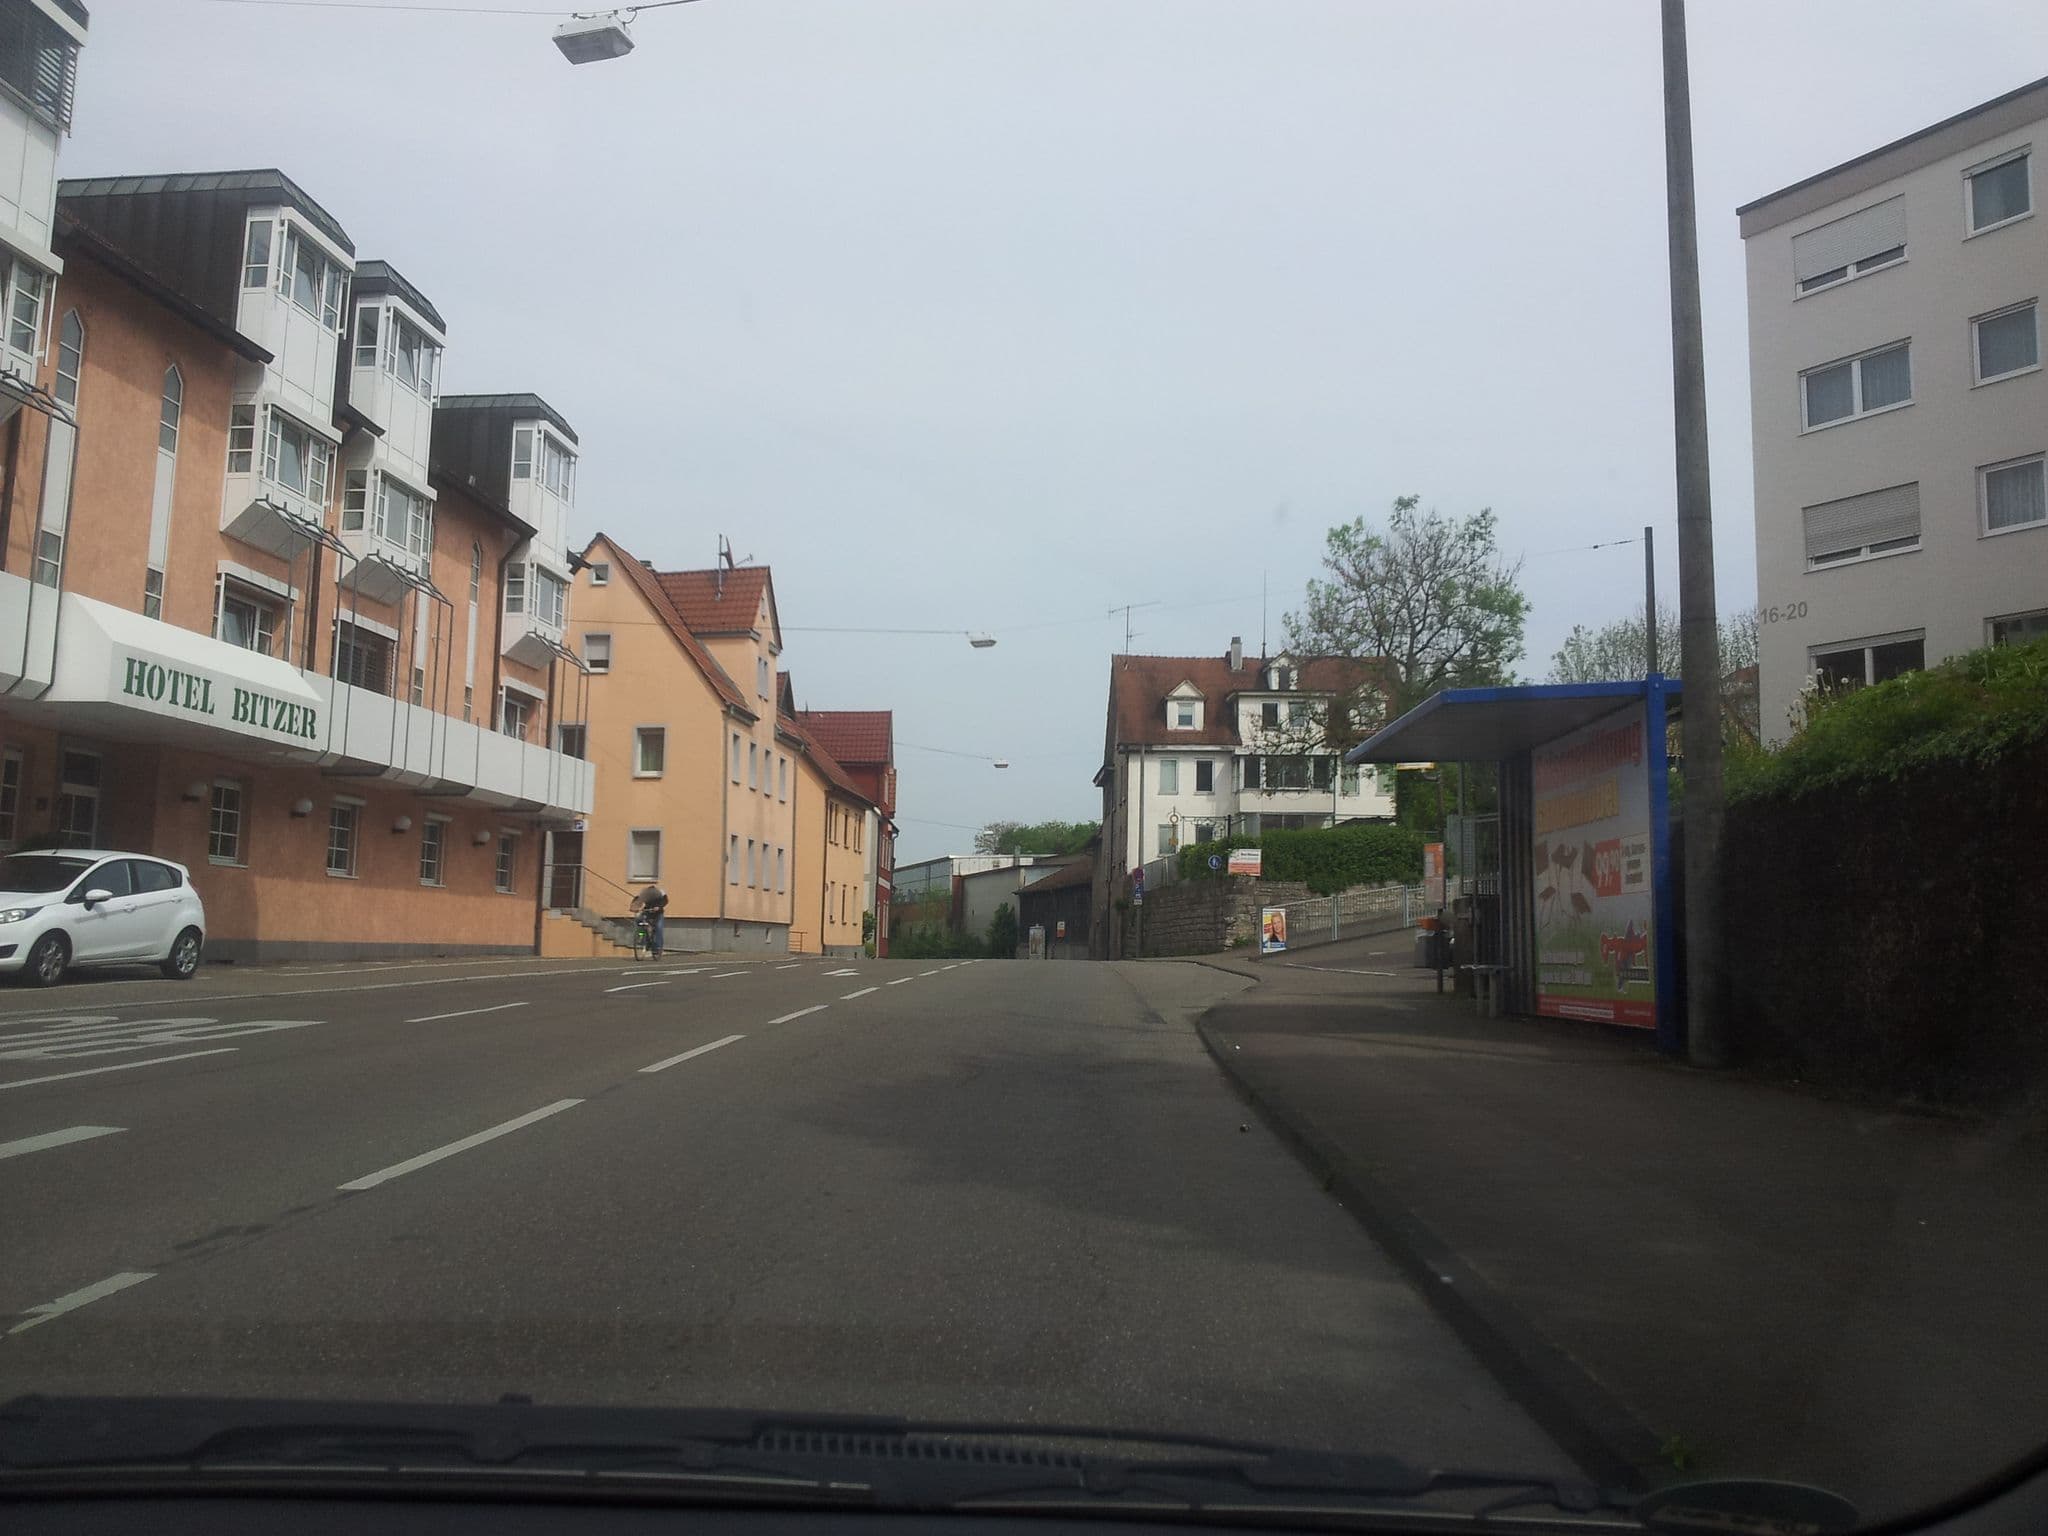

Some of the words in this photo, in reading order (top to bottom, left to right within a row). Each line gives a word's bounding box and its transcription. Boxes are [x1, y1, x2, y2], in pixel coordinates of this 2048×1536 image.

[1760, 601, 1808, 625] 16-20
[123, 657, 215, 715] HOTEL
[231, 687, 318, 741] BITZER
